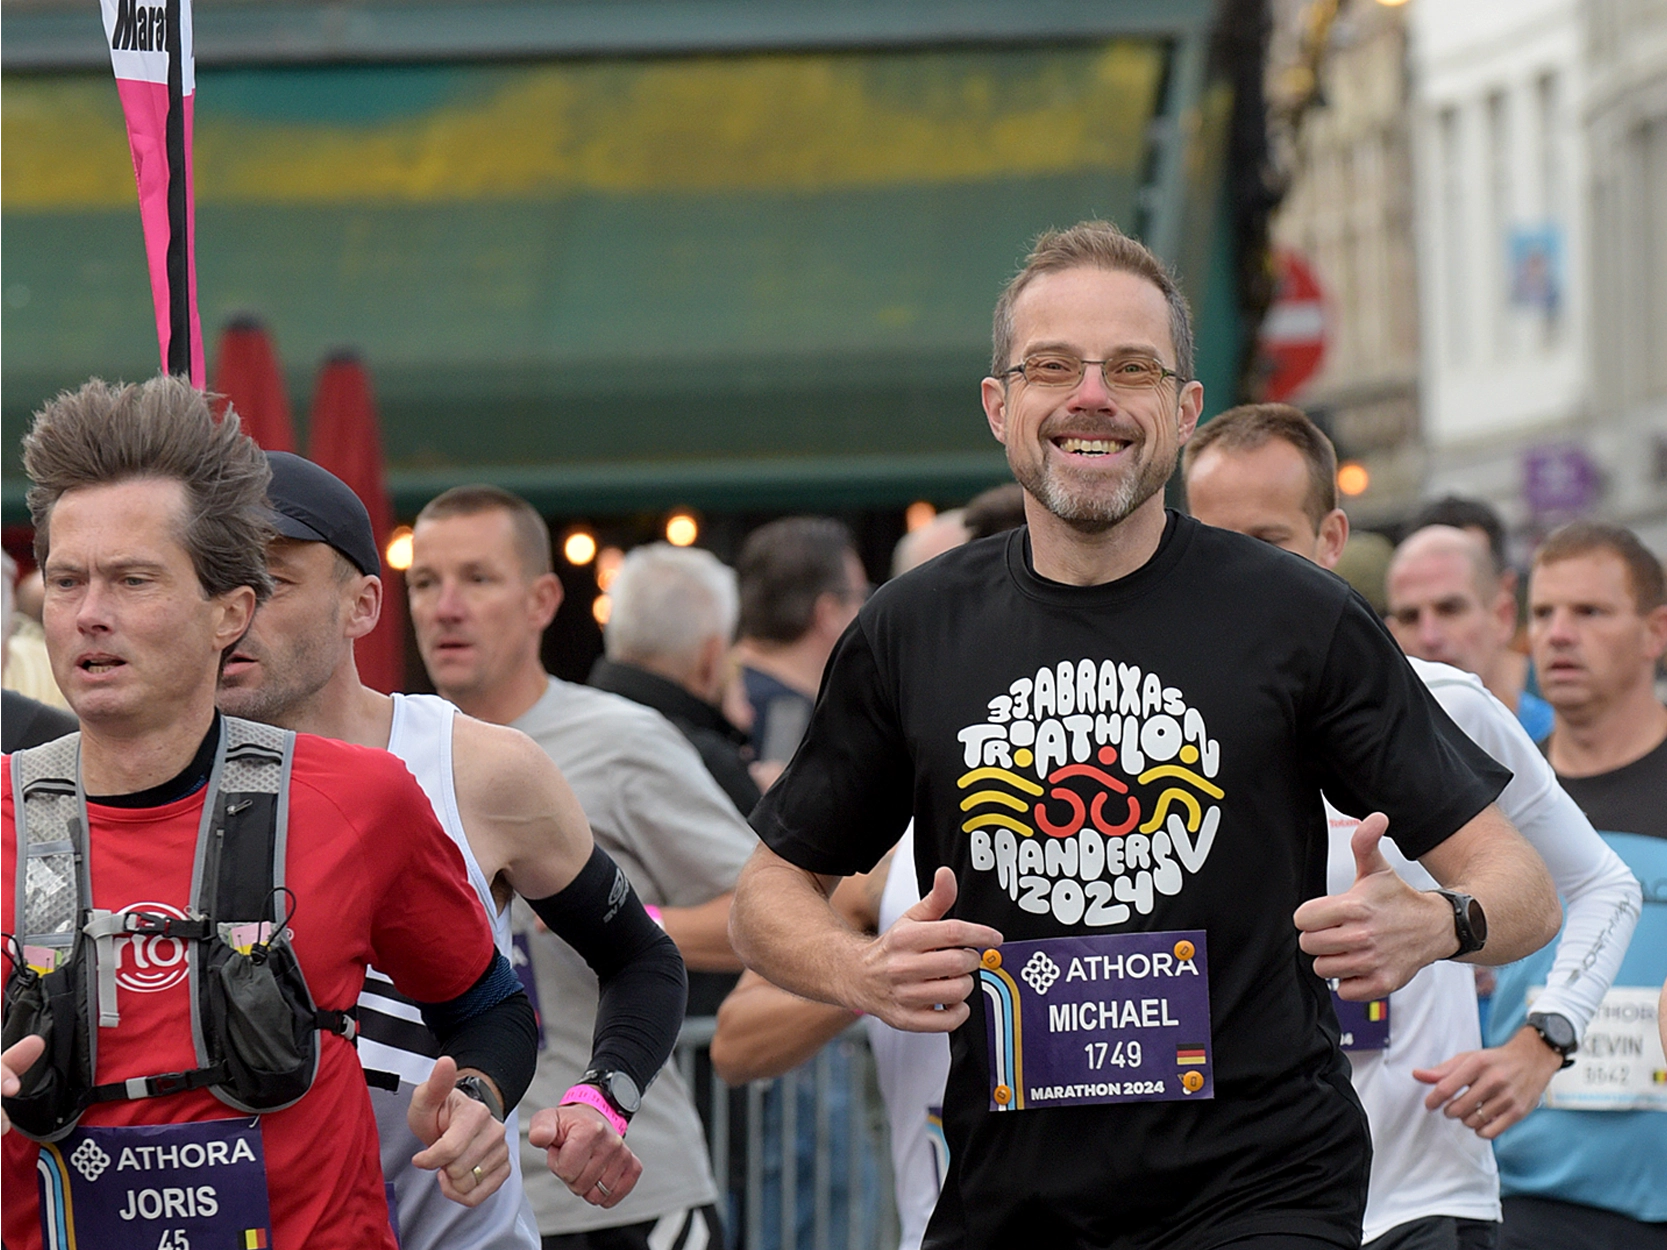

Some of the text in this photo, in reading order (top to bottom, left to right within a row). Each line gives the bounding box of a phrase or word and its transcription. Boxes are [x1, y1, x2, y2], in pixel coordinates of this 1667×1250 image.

[112, 0, 168, 52] Mara
[1033, 658, 1187, 721] ABRAXAS
[957, 708, 1220, 779] TRIATHLON
[1018, 870, 1154, 926] 2024
[1065, 953, 1199, 982] ATHORA
[1049, 999, 1179, 1033] MICHAEL
[1084, 1041, 1142, 1070] 1749
[1031, 1080, 1165, 1101] MARATHON 2024
[116, 1138, 257, 1172] ATHORA
[119, 1186, 219, 1221] JORIS
